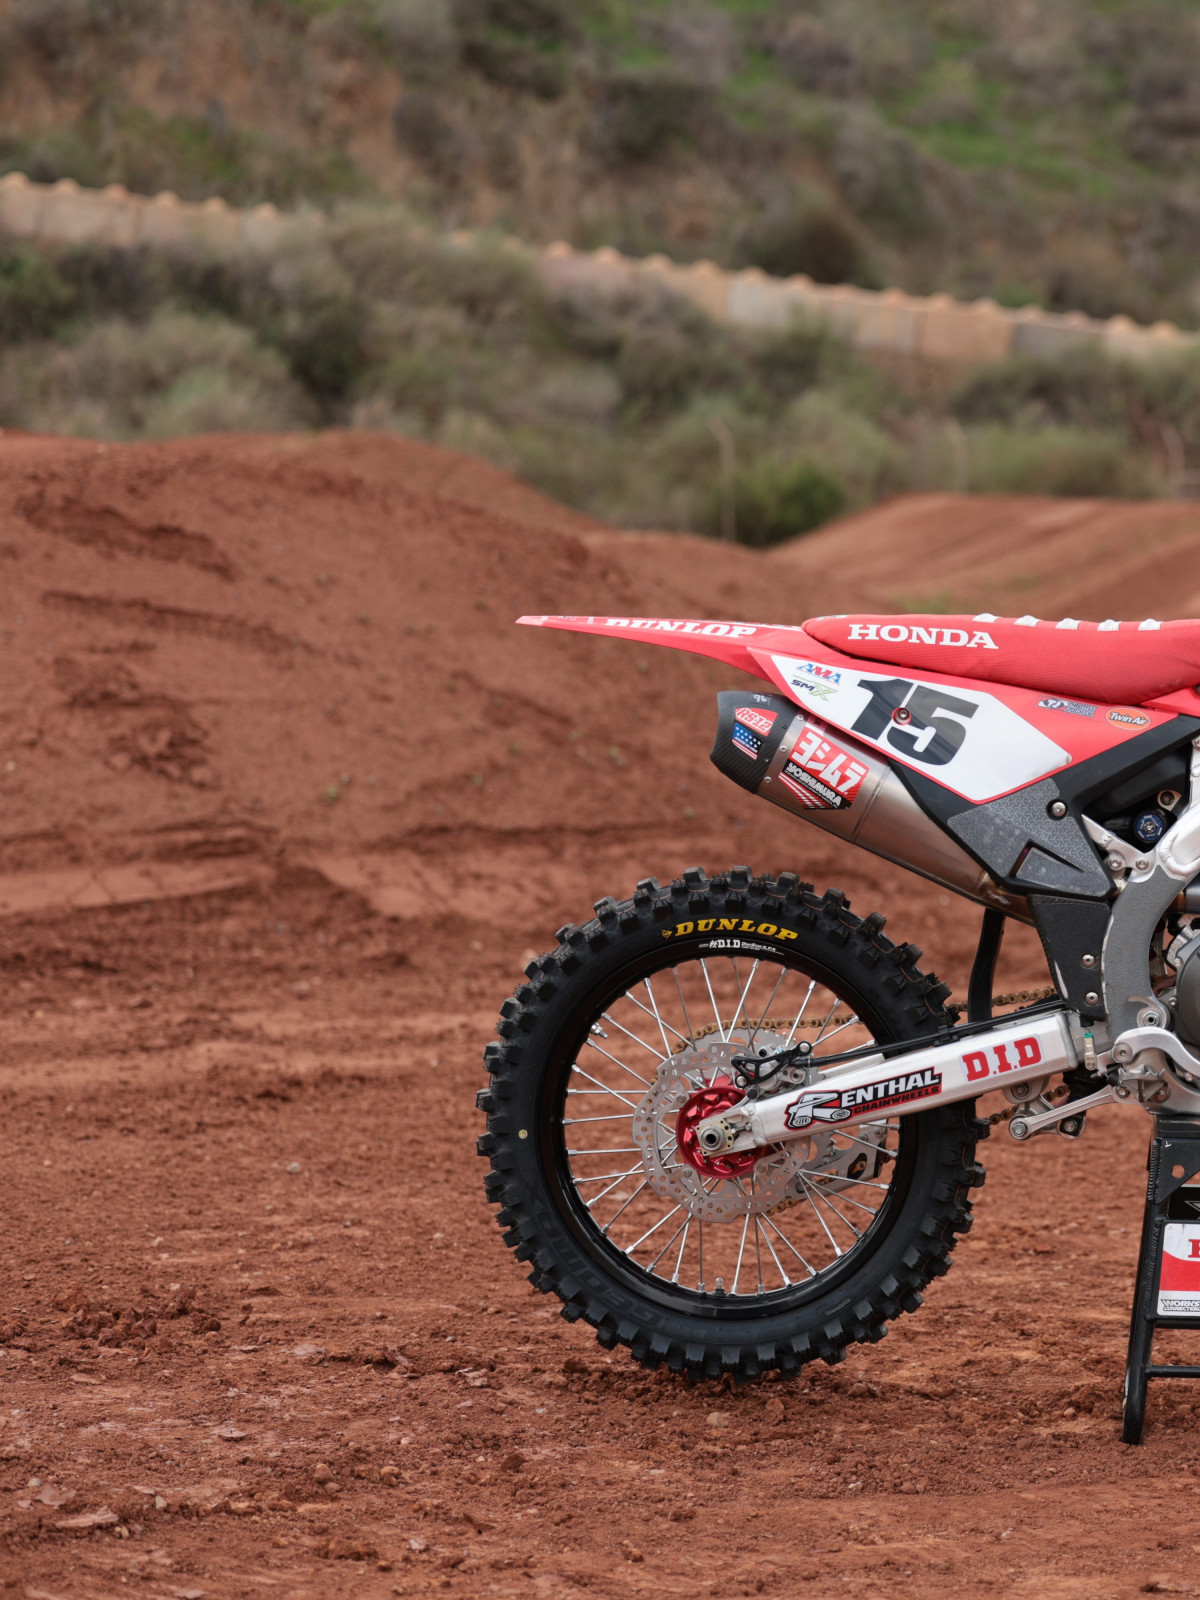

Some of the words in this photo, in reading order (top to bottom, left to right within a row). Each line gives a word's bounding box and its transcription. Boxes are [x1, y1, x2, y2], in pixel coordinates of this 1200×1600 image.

[605, 619, 757, 638] DUNLOP
[848, 624, 999, 650] HONDA
[796, 663, 842, 684] AMA
[850, 678, 980, 766] 15
[1110, 712, 1132, 723] Twin
[1132, 717, 1148, 726] Air
[791, 731, 867, 793] ヨシムラ
[786, 762, 842, 807] YOSHIMURA
[674, 918, 799, 940] DUNLOP
[962, 1036, 1042, 1082] D.I.D
[854, 1085, 940, 1116] CHAINWHEELS
